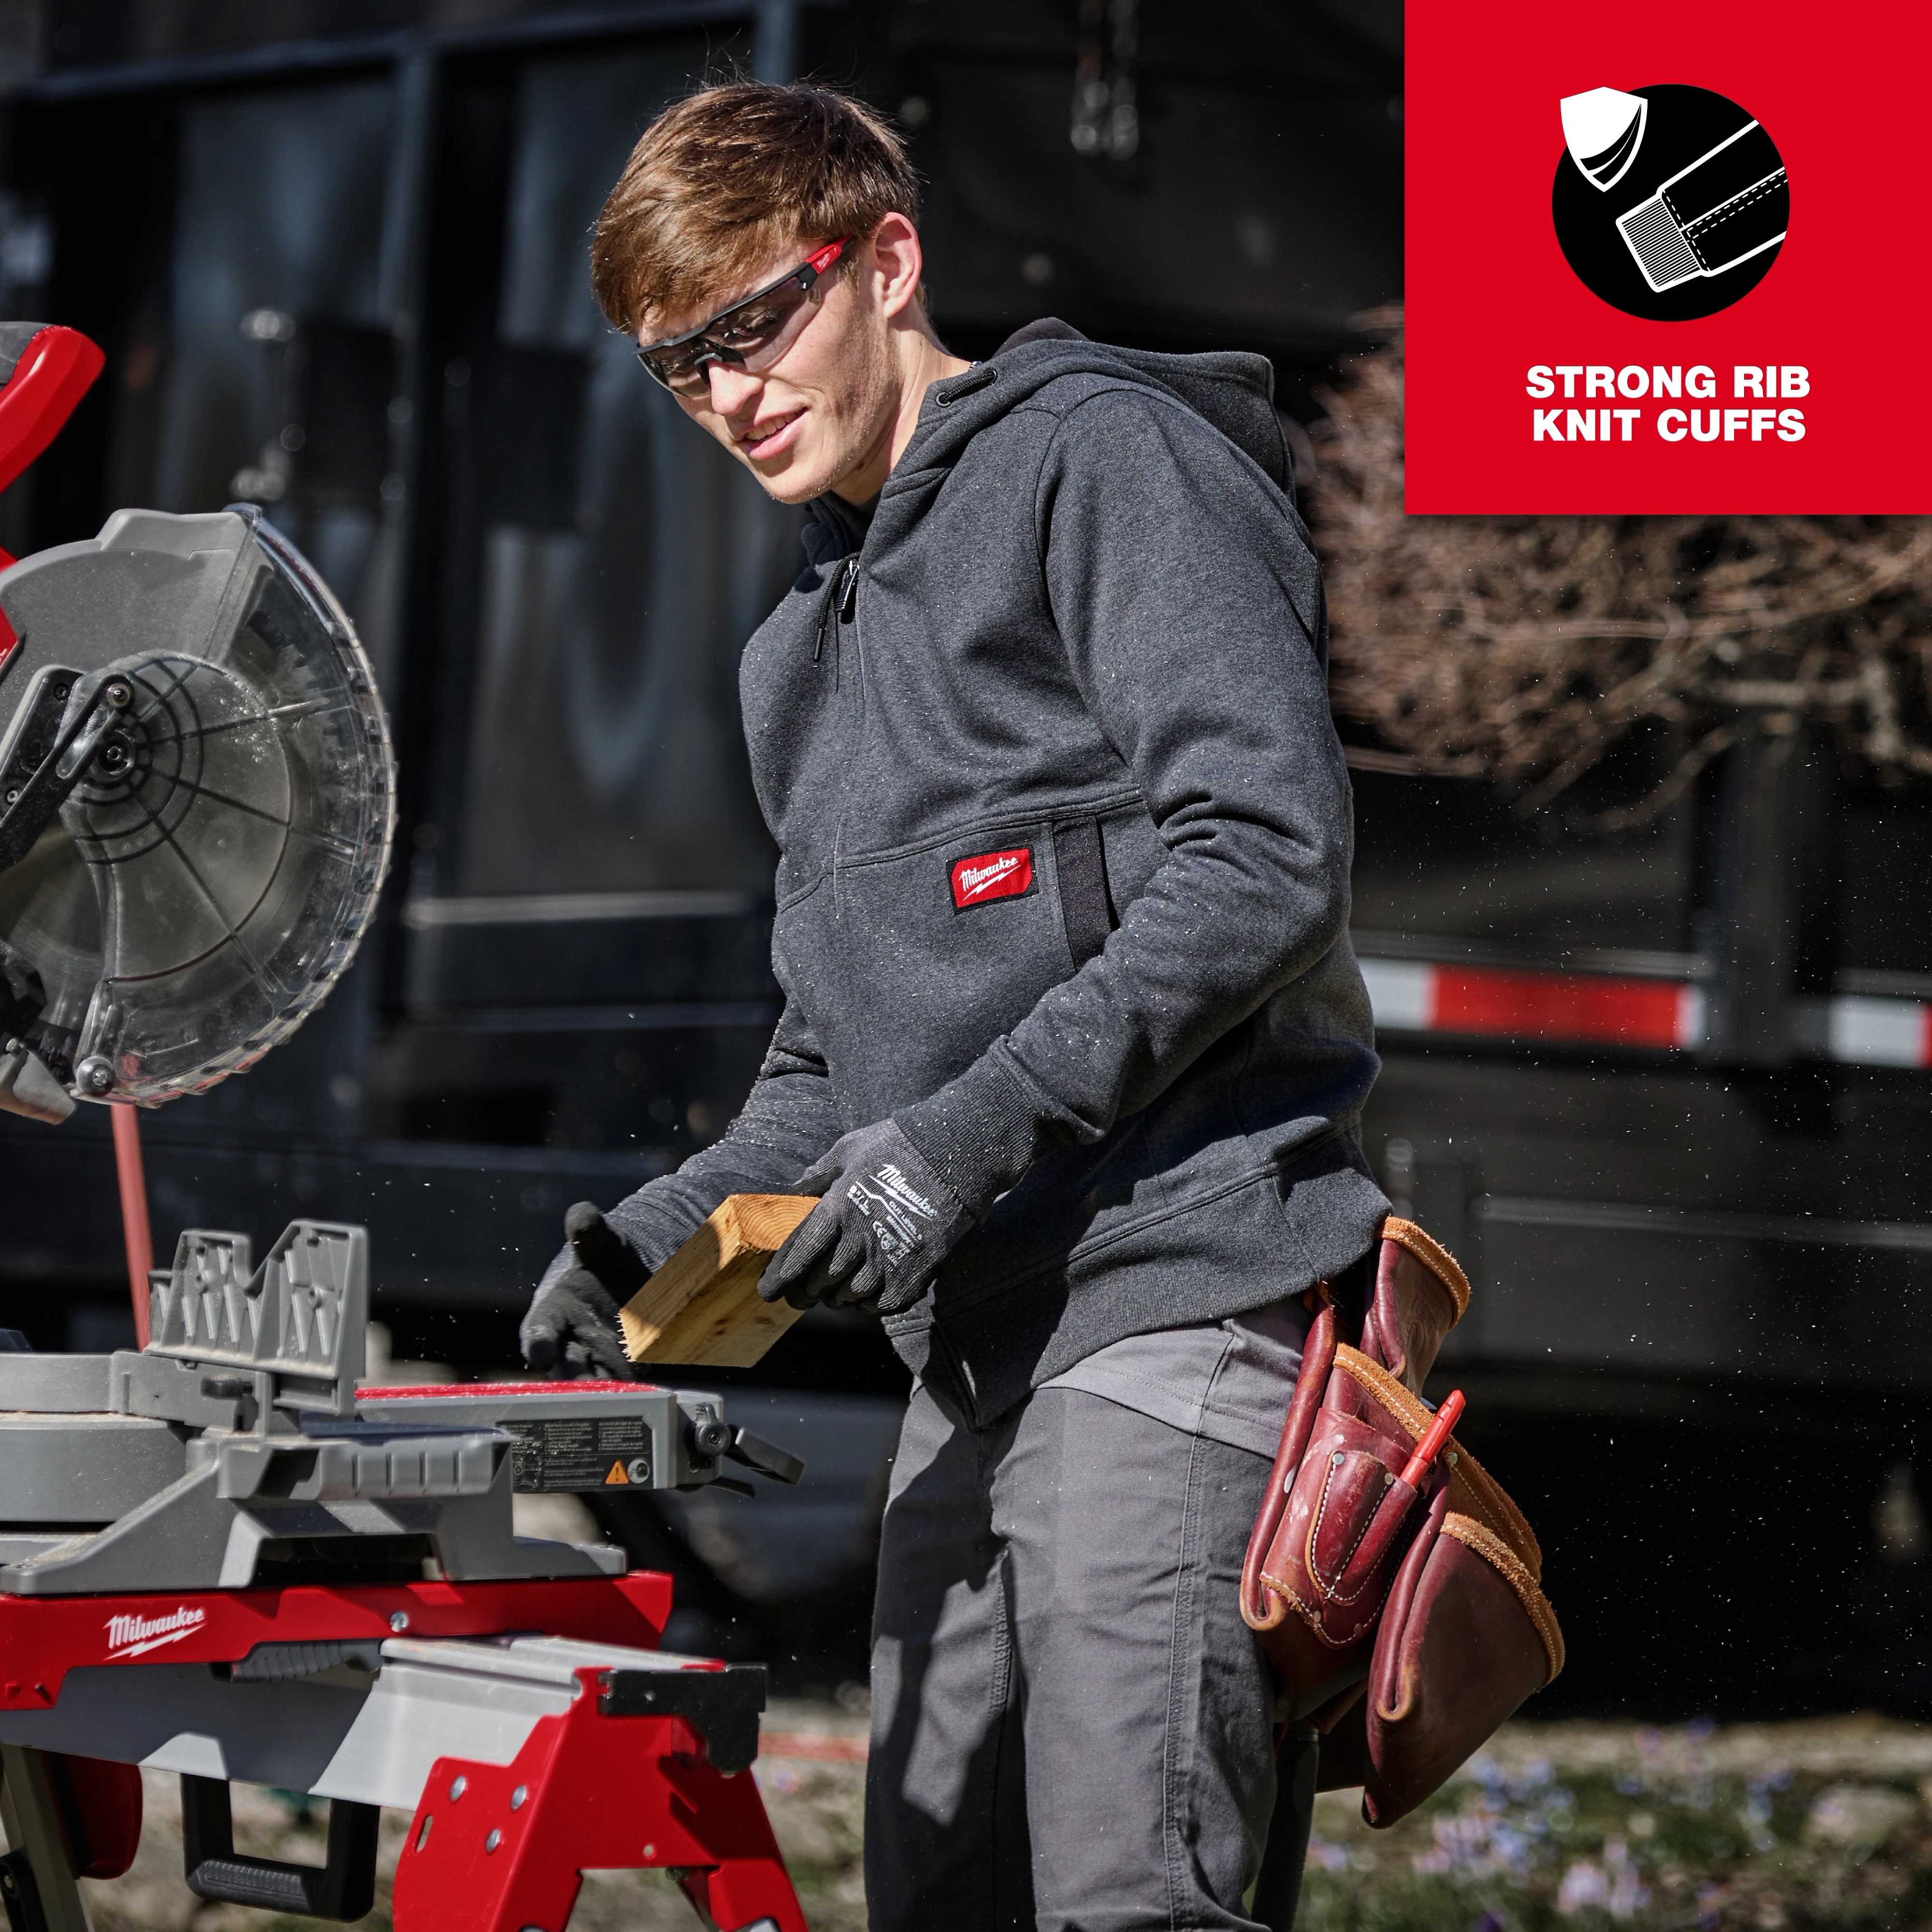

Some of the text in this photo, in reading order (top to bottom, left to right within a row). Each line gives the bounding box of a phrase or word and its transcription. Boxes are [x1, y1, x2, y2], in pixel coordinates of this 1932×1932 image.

[959, 857, 1018, 891] Milwaukee
[877, 1164, 936, 1217] Milwaukee
[102, 1607, 205, 1649] Milwaukee
